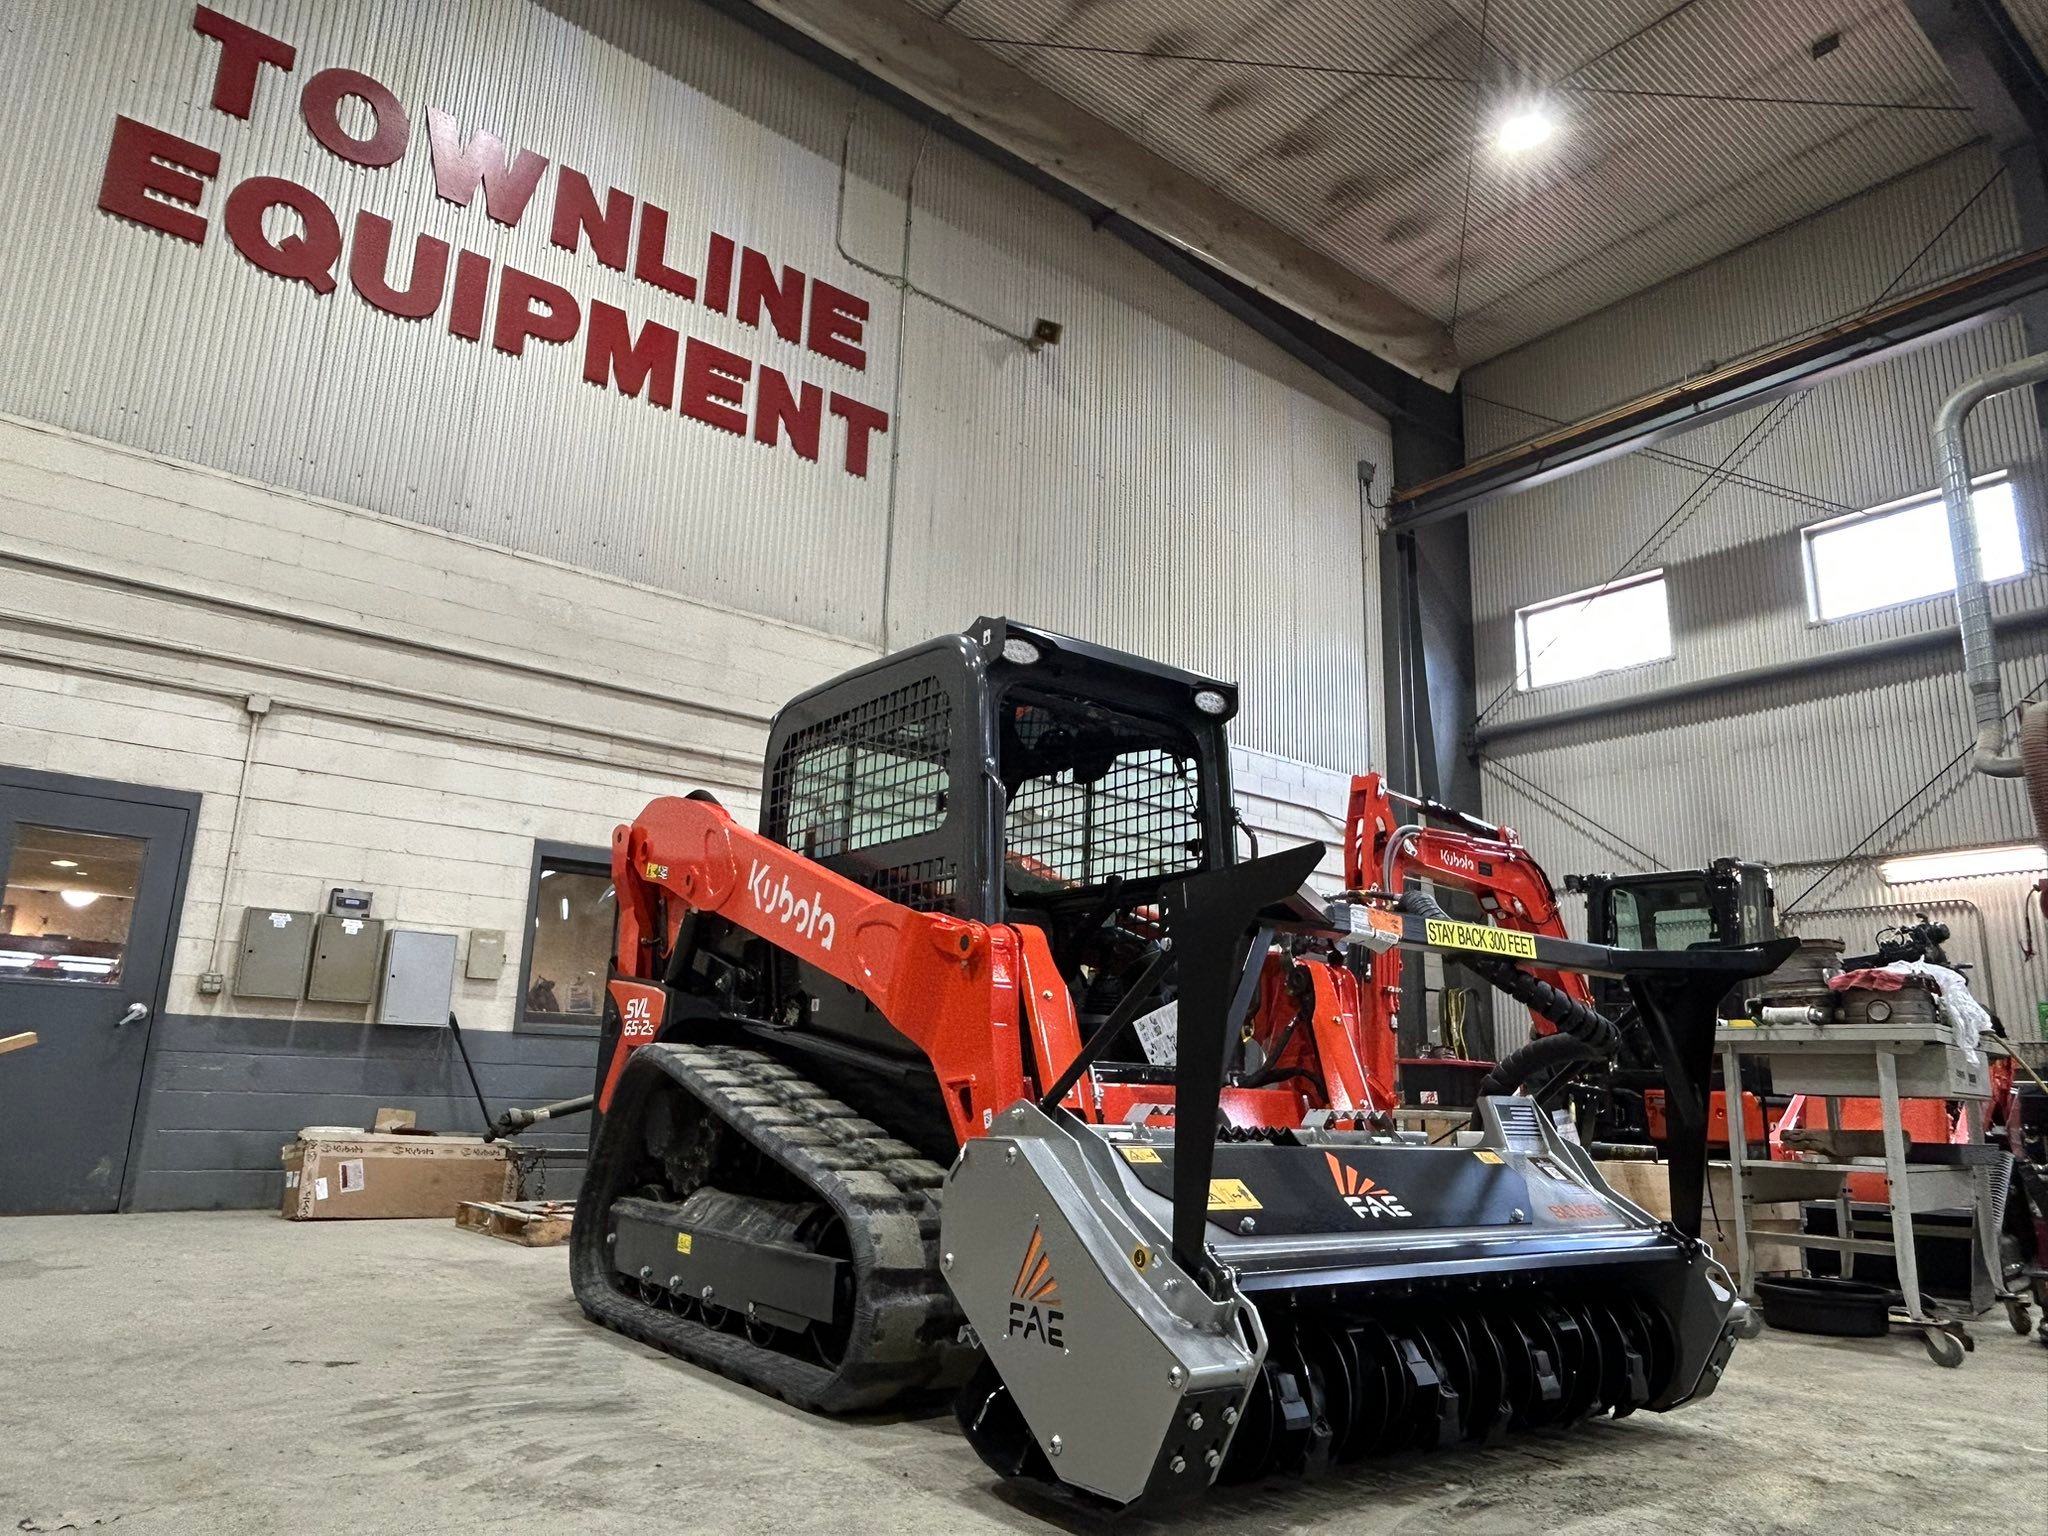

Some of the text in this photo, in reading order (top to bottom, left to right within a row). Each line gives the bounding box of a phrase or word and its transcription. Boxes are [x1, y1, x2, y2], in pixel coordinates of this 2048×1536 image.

[194, 5, 869, 370] TOWNLINE
[99, 115, 888, 477] EQUIPMENT
[1440, 850, 1474, 870] Kubota
[747, 859, 835, 951] Kubota
[1428, 922, 1532, 955] STAY BACK 300 FEET
[624, 997, 650, 1019] SVL
[405, 1147, 434, 1155] Kubota
[1343, 1195, 1412, 1219] FAE
[1009, 1302, 1064, 1348] FAE
